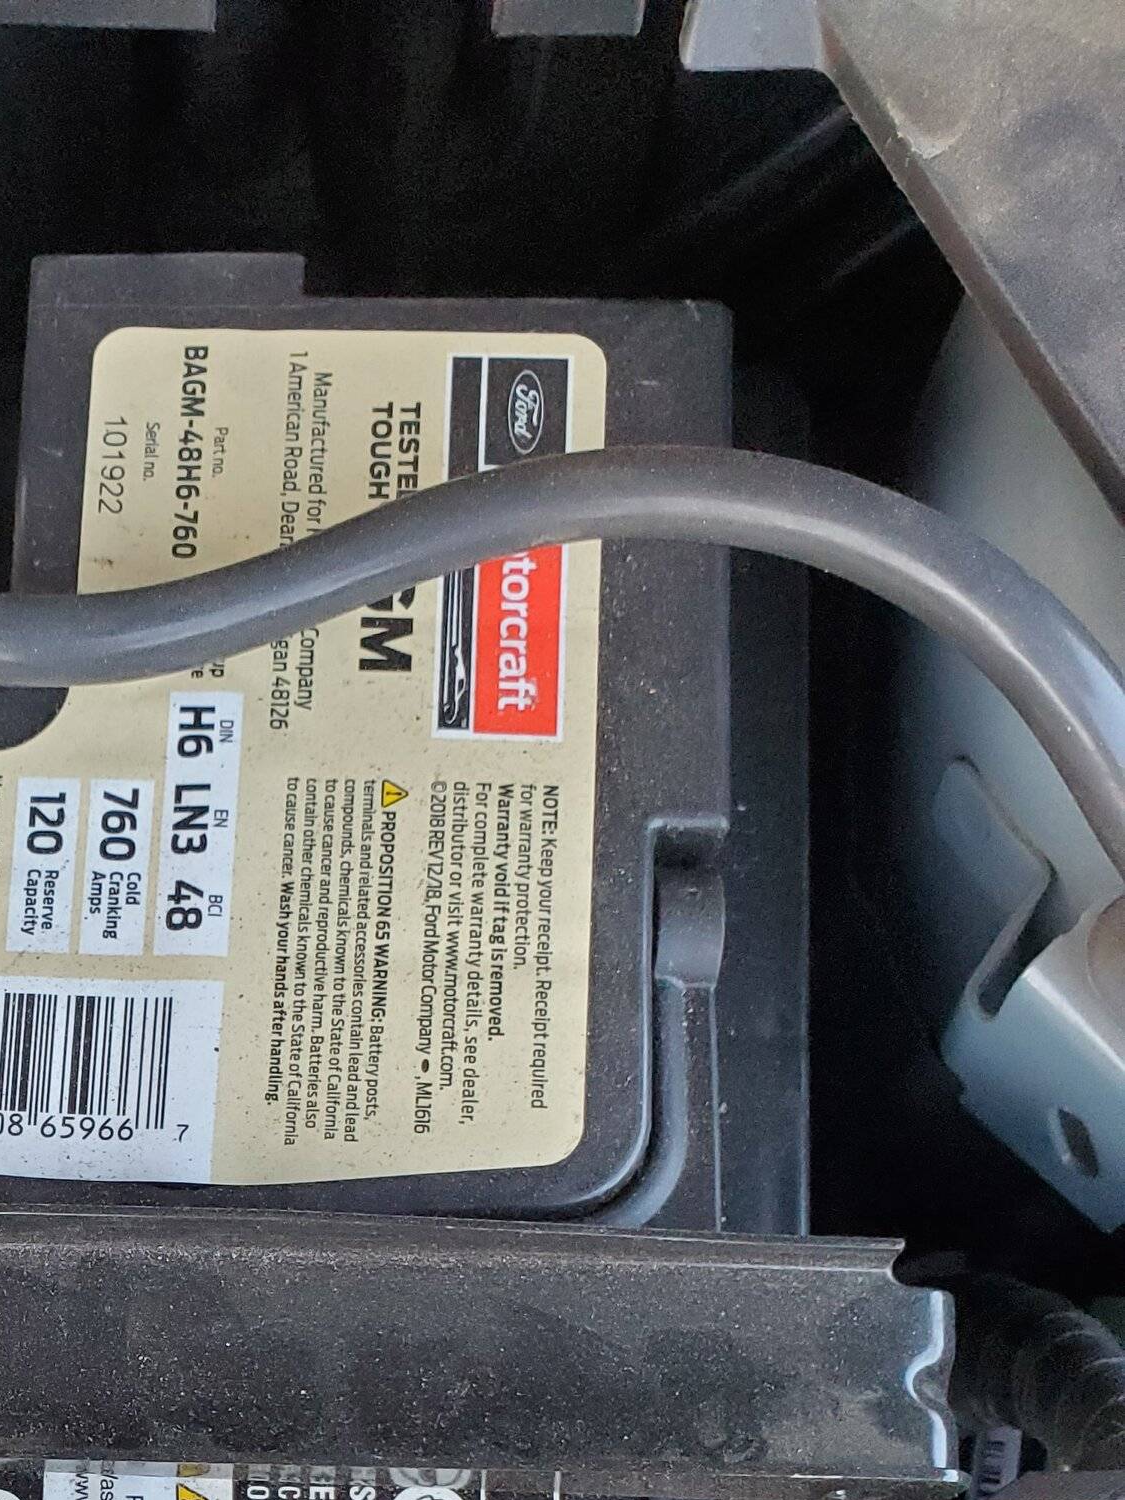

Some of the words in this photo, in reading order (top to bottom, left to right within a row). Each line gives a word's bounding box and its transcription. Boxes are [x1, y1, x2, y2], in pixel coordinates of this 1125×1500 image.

[285, 362, 307, 441] American
[514, 384, 539, 437] Ford
[143, 422, 160, 458] Serial
[172, 345, 209, 559] BAGM-48H6-760
[213, 427, 228, 454] Part
[307, 372, 332, 494] Manufactured
[368, 402, 393, 499] TOUGH
[98, 415, 127, 515] 101922
[142, 461, 155, 481] no.
[212, 456, 223, 478] no.
[280, 447, 303, 496] Road,
[306, 500, 326, 524] for
[270, 676, 290, 730] 48126
[177, 706, 215, 758] H6
[219, 720, 234, 743] DIN
[284, 777, 300, 791] to
[474, 782, 491, 808] For
[541, 784, 558, 834] NOTE:
[27, 791, 67, 855] 120
[99, 787, 139, 861] 760
[171, 783, 211, 855] LN3
[213, 809, 228, 829] EN
[282, 793, 296, 830] cause
[448, 781, 468, 868] distributor
[491, 783, 513, 859] Warranty
[279, 833, 293, 878] cancer.
[375, 811, 396, 917] PROPOSITION
[467, 811, 490, 887] complete
[536, 838, 556, 877] Keep
[21, 869, 42, 936] Capacity
[41, 870, 60, 930] Reserve
[88, 871, 105, 915] Amps
[126, 871, 142, 905] Cold
[277, 881, 294, 919] Wash
[447, 871, 460, 888] or
[493, 862, 510, 897] void
[534, 880, 551, 914] your
[102, 871, 124, 940] Cranking
[165, 880, 203, 931] 48
[207, 894, 222, 918] BCI
[374, 920, 391, 940] 65
[446, 891, 463, 926] visit
[463, 891, 486, 967] warranty
[487, 916, 508, 944] tag
[492, 901, 509, 913] if
[271, 921, 288, 953] your
[490, 948, 507, 961] is
[532, 917, 554, 976] receipt.
[272, 955, 289, 998] hands
[369, 943, 389, 1022] WARNING:
[460, 970, 483, 1031] details,
[270, 1000, 287, 1036] after
[438, 930, 461, 1090] www.motorcraft.com.
[487, 964, 506, 1041] removed.
[530, 979, 552, 1038] Receipt
[262, 1039, 284, 1105] handling.
[363, 1025, 385, 1076] Battery
[462, 1036, 476, 1064] see
[528, 1042, 549, 1108] required
[361, 1079, 382, 1120] posts,
[414, 1082, 432, 1133] ML1616
[456, 1068, 478, 1124] dealer,
[40, 1116, 134, 1141] 65966
